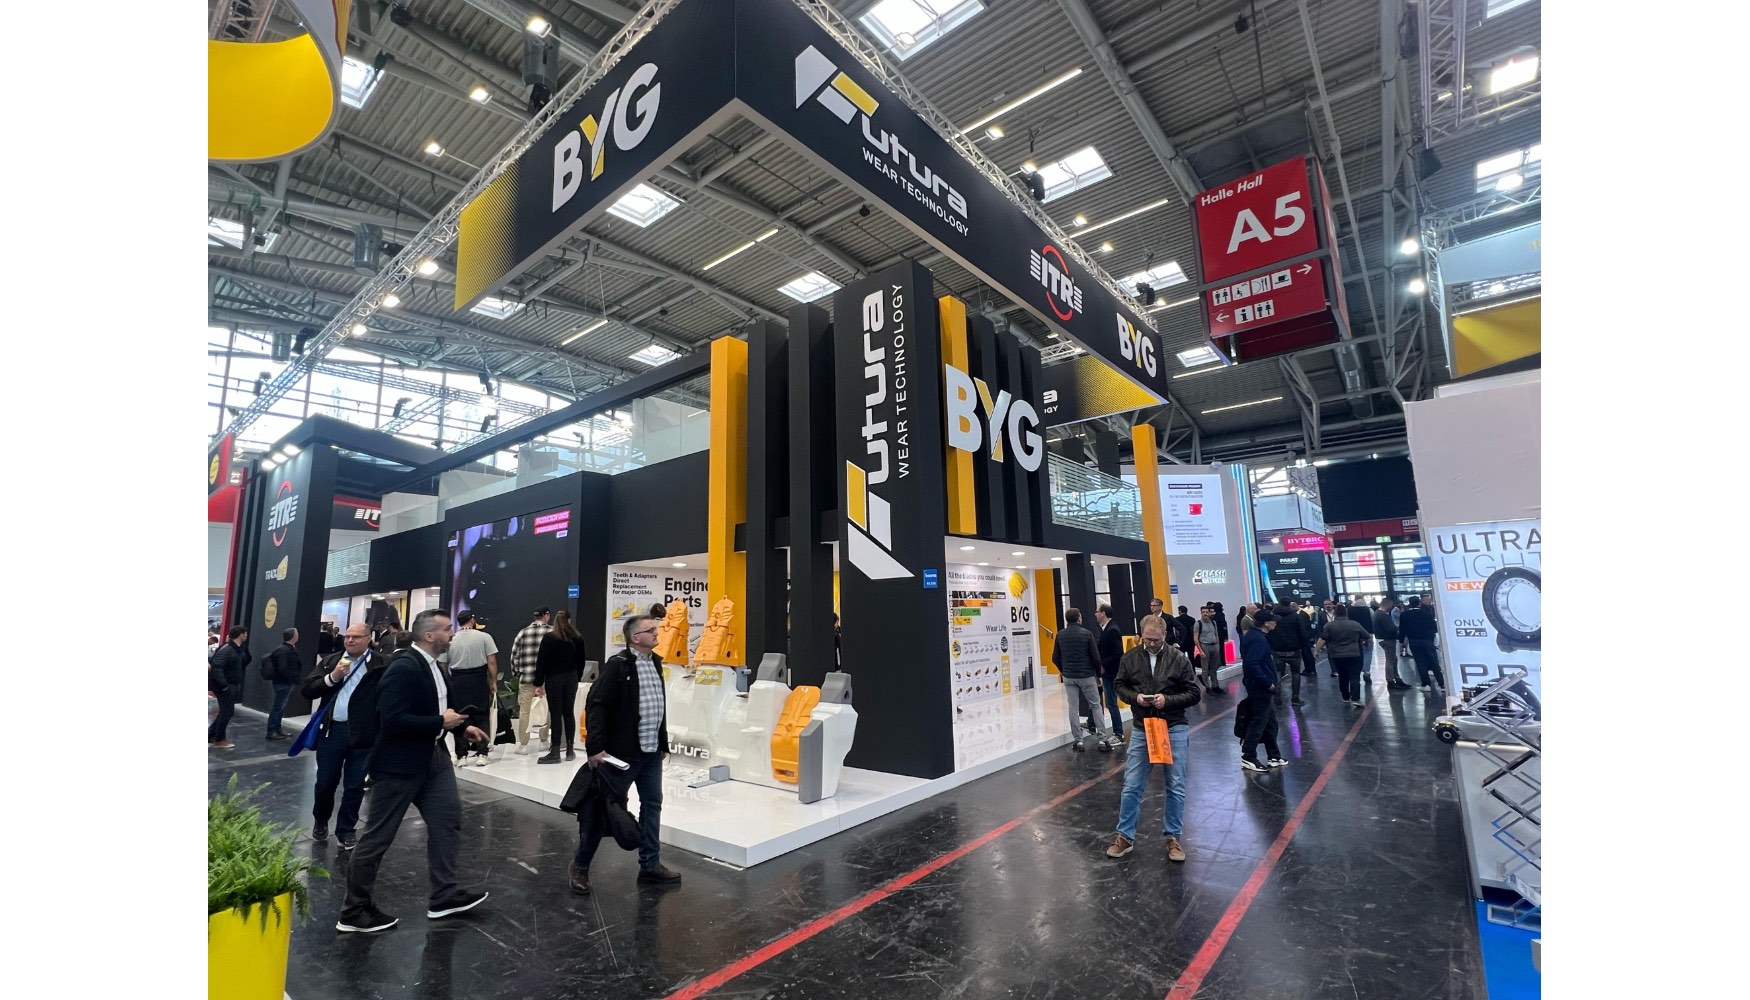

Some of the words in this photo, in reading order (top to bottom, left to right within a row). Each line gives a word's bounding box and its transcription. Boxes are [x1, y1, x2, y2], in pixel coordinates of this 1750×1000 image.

[552, 62, 661, 213] BYG
[862, 146, 899, 184] WEAR
[899, 175, 969, 237] TECHNOLOGY
[1201, 188, 1234, 207] Halle
[1237, 174, 1264, 193] Hall
[1226, 190, 1306, 254] A5
[891, 284, 907, 415] TECHNOLOGY
[1116, 312, 1157, 378] BYG
[945, 363, 1043, 472] BYG
[896, 420, 910, 478] WEAR
[363, 508, 382, 520] IT
[1437, 528, 1541, 554] ULTRA
[664, 594, 702, 608] Prts
[1447, 582, 1484, 591] NEW
[1010, 606, 1030, 623] BYG
[1454, 619, 1485, 627] ONLY
[668, 742, 710, 760] utura
